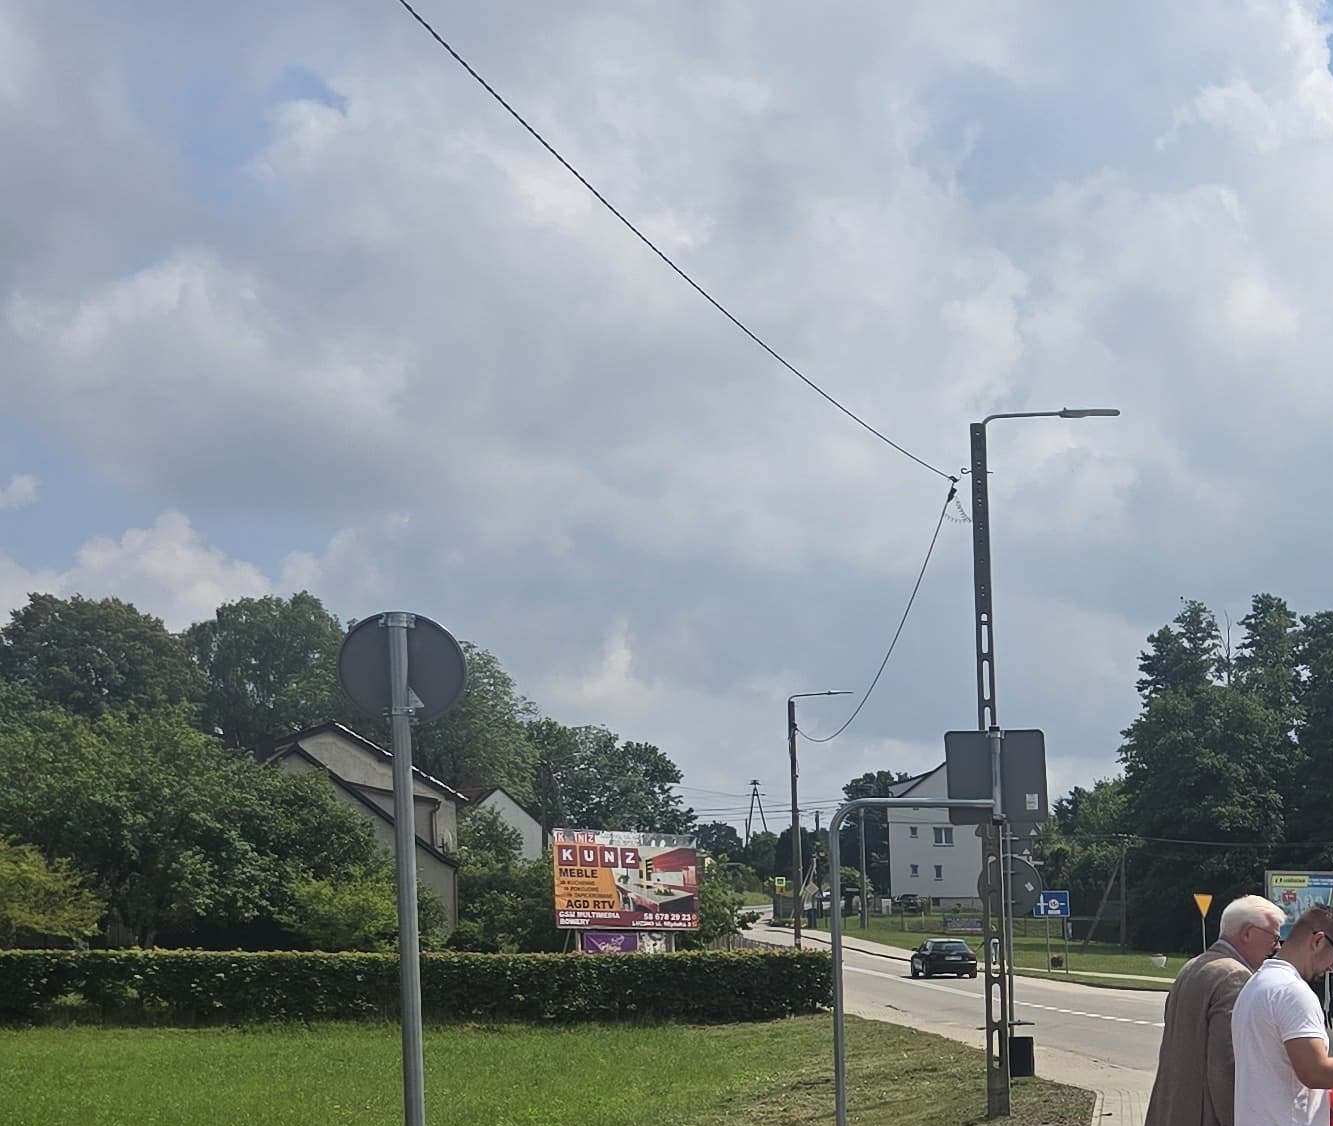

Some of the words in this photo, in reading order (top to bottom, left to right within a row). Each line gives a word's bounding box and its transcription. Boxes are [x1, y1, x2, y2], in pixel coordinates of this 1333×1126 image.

[561, 848, 636, 864] KUNZ
[559, 868, 598, 878] MEBLE
[566, 900, 590, 909] AGD
[593, 901, 615, 910] RTV
